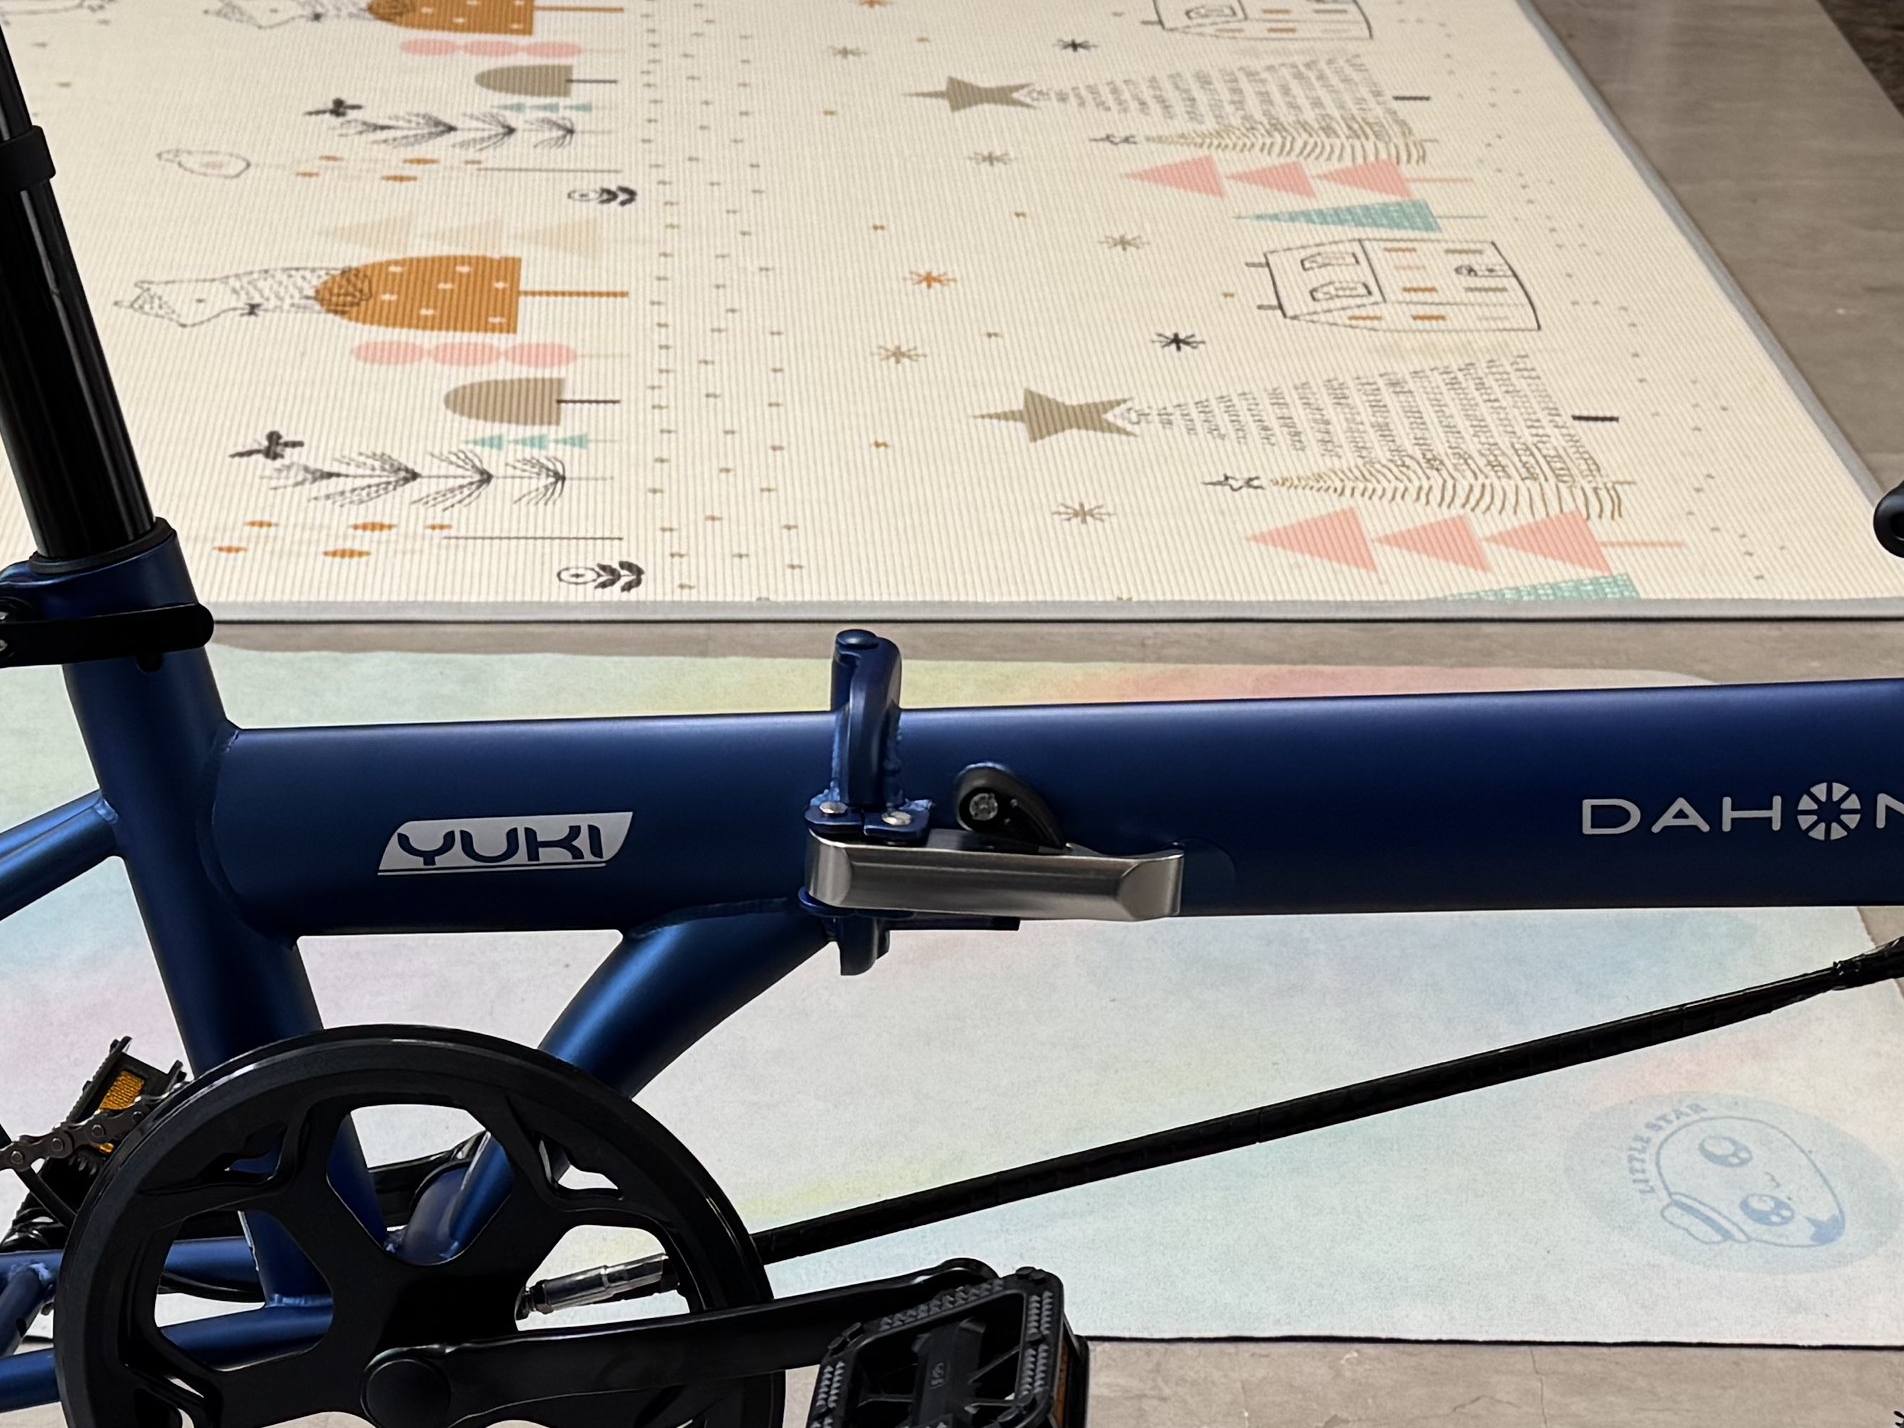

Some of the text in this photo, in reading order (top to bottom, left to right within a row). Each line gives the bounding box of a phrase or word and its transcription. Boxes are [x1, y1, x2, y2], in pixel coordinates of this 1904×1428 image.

[397, 824, 604, 867] YUKI
[1626, 1102, 1709, 1194] LITTLE STAR
